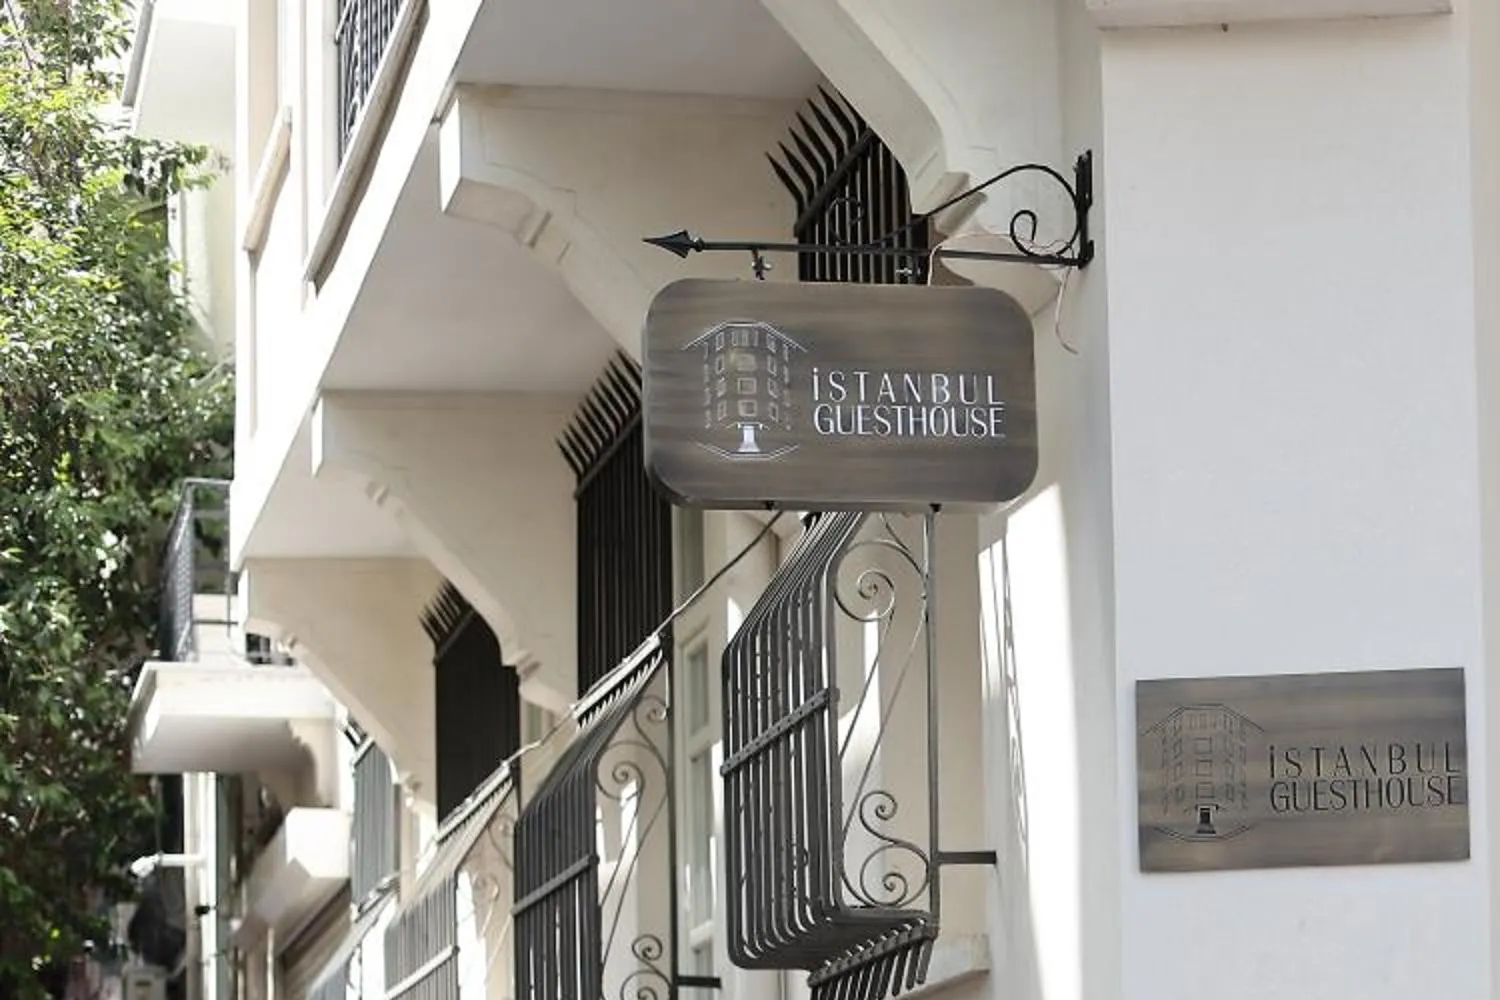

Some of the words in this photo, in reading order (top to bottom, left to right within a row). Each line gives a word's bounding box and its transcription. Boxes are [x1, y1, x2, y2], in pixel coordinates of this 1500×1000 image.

[812, 367, 1006, 405] İSTANBUL
[813, 403, 1007, 439] GUESTHOUSE
[1268, 742, 1461, 778] İSTANBUL
[1269, 775, 1466, 813] GUESTHOUSE
